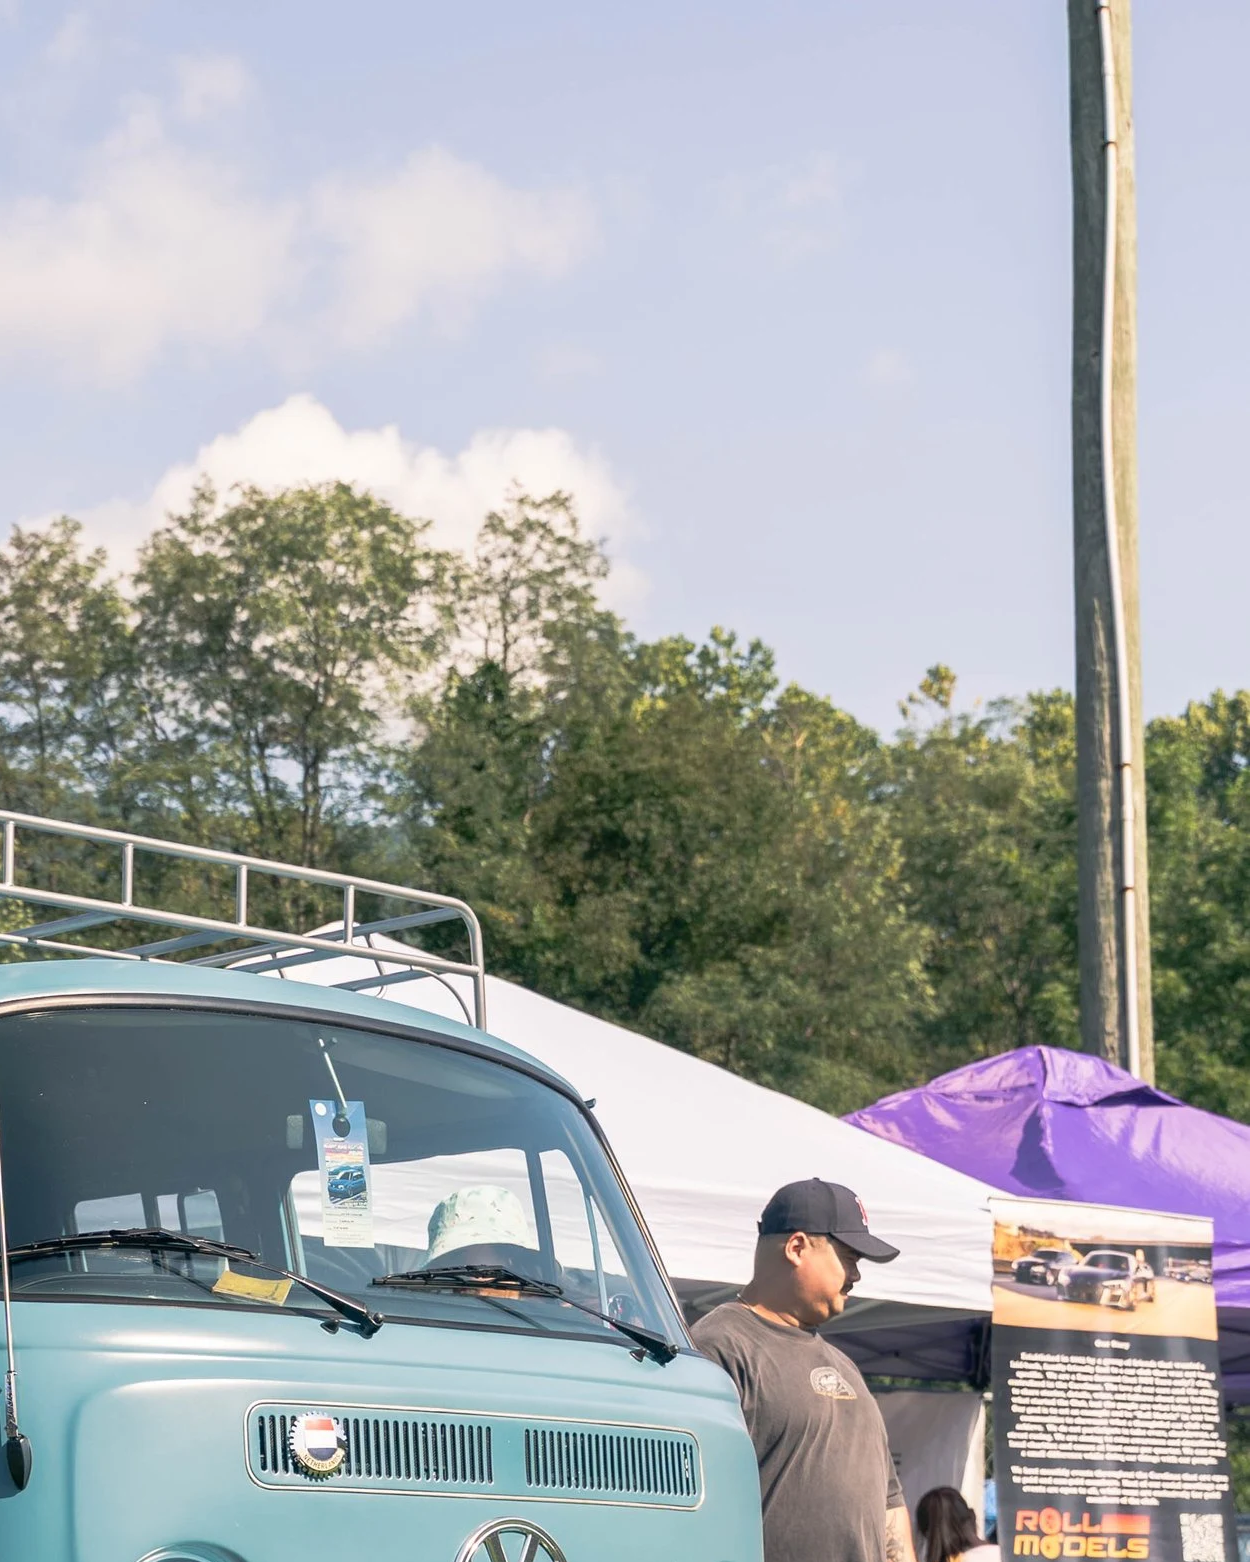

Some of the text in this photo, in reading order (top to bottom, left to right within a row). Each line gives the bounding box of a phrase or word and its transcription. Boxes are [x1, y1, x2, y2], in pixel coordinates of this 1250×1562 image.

[303, 1454, 341, 1470] NETHERLANDS
[1015, 1506, 1101, 1535] ROLL
[1013, 1534, 1150, 1560] MODELS
